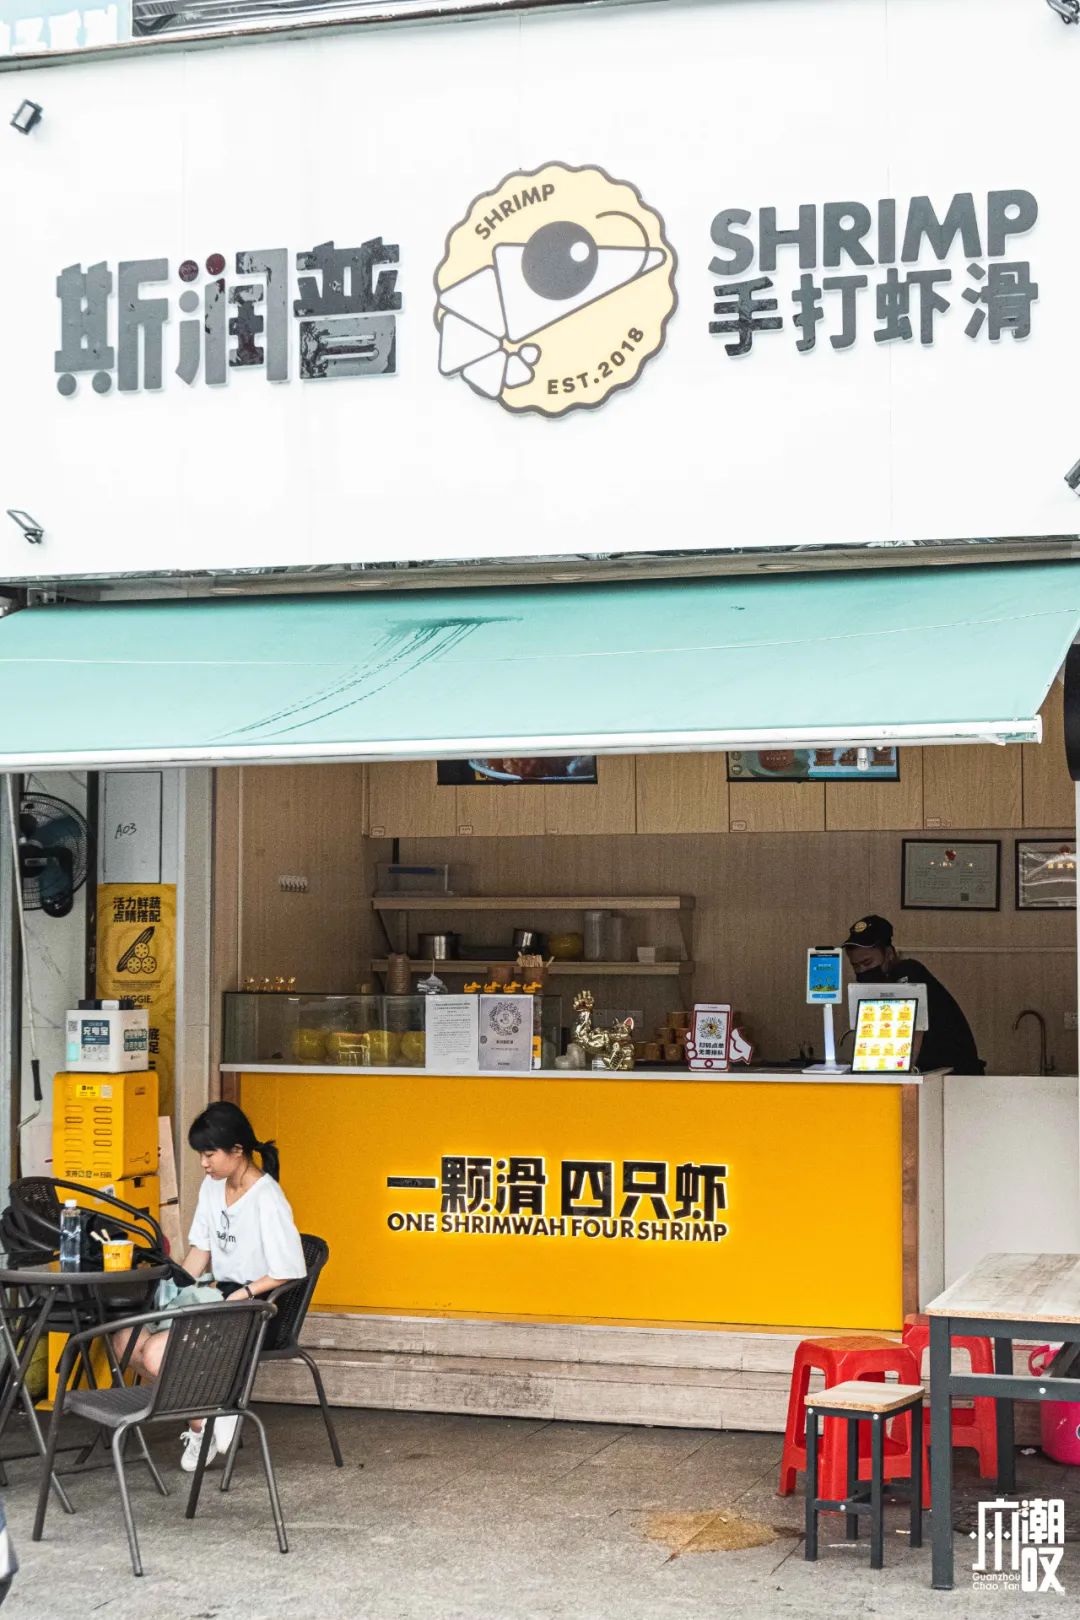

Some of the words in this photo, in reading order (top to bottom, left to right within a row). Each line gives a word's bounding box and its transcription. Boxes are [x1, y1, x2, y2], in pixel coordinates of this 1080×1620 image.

[474, 182, 557, 242] SHRIMP
[709, 188, 1038, 276] SHRIMP
[54, 236, 403, 397] 斯润普
[709, 261, 1039, 358] 手打虾滑
[546, 325, 645, 396] EST.2018
[114, 822, 137, 840] A03
[113, 896, 161, 910] 活力鲜蔬
[113, 910, 161, 923] 点睛搭配
[387, 1213, 436, 1232] ONE
[441, 1214, 566, 1237] SHRIMWAH
[571, 1219, 635, 1239] FOUR
[638, 1221, 728, 1242] SHRIMP
